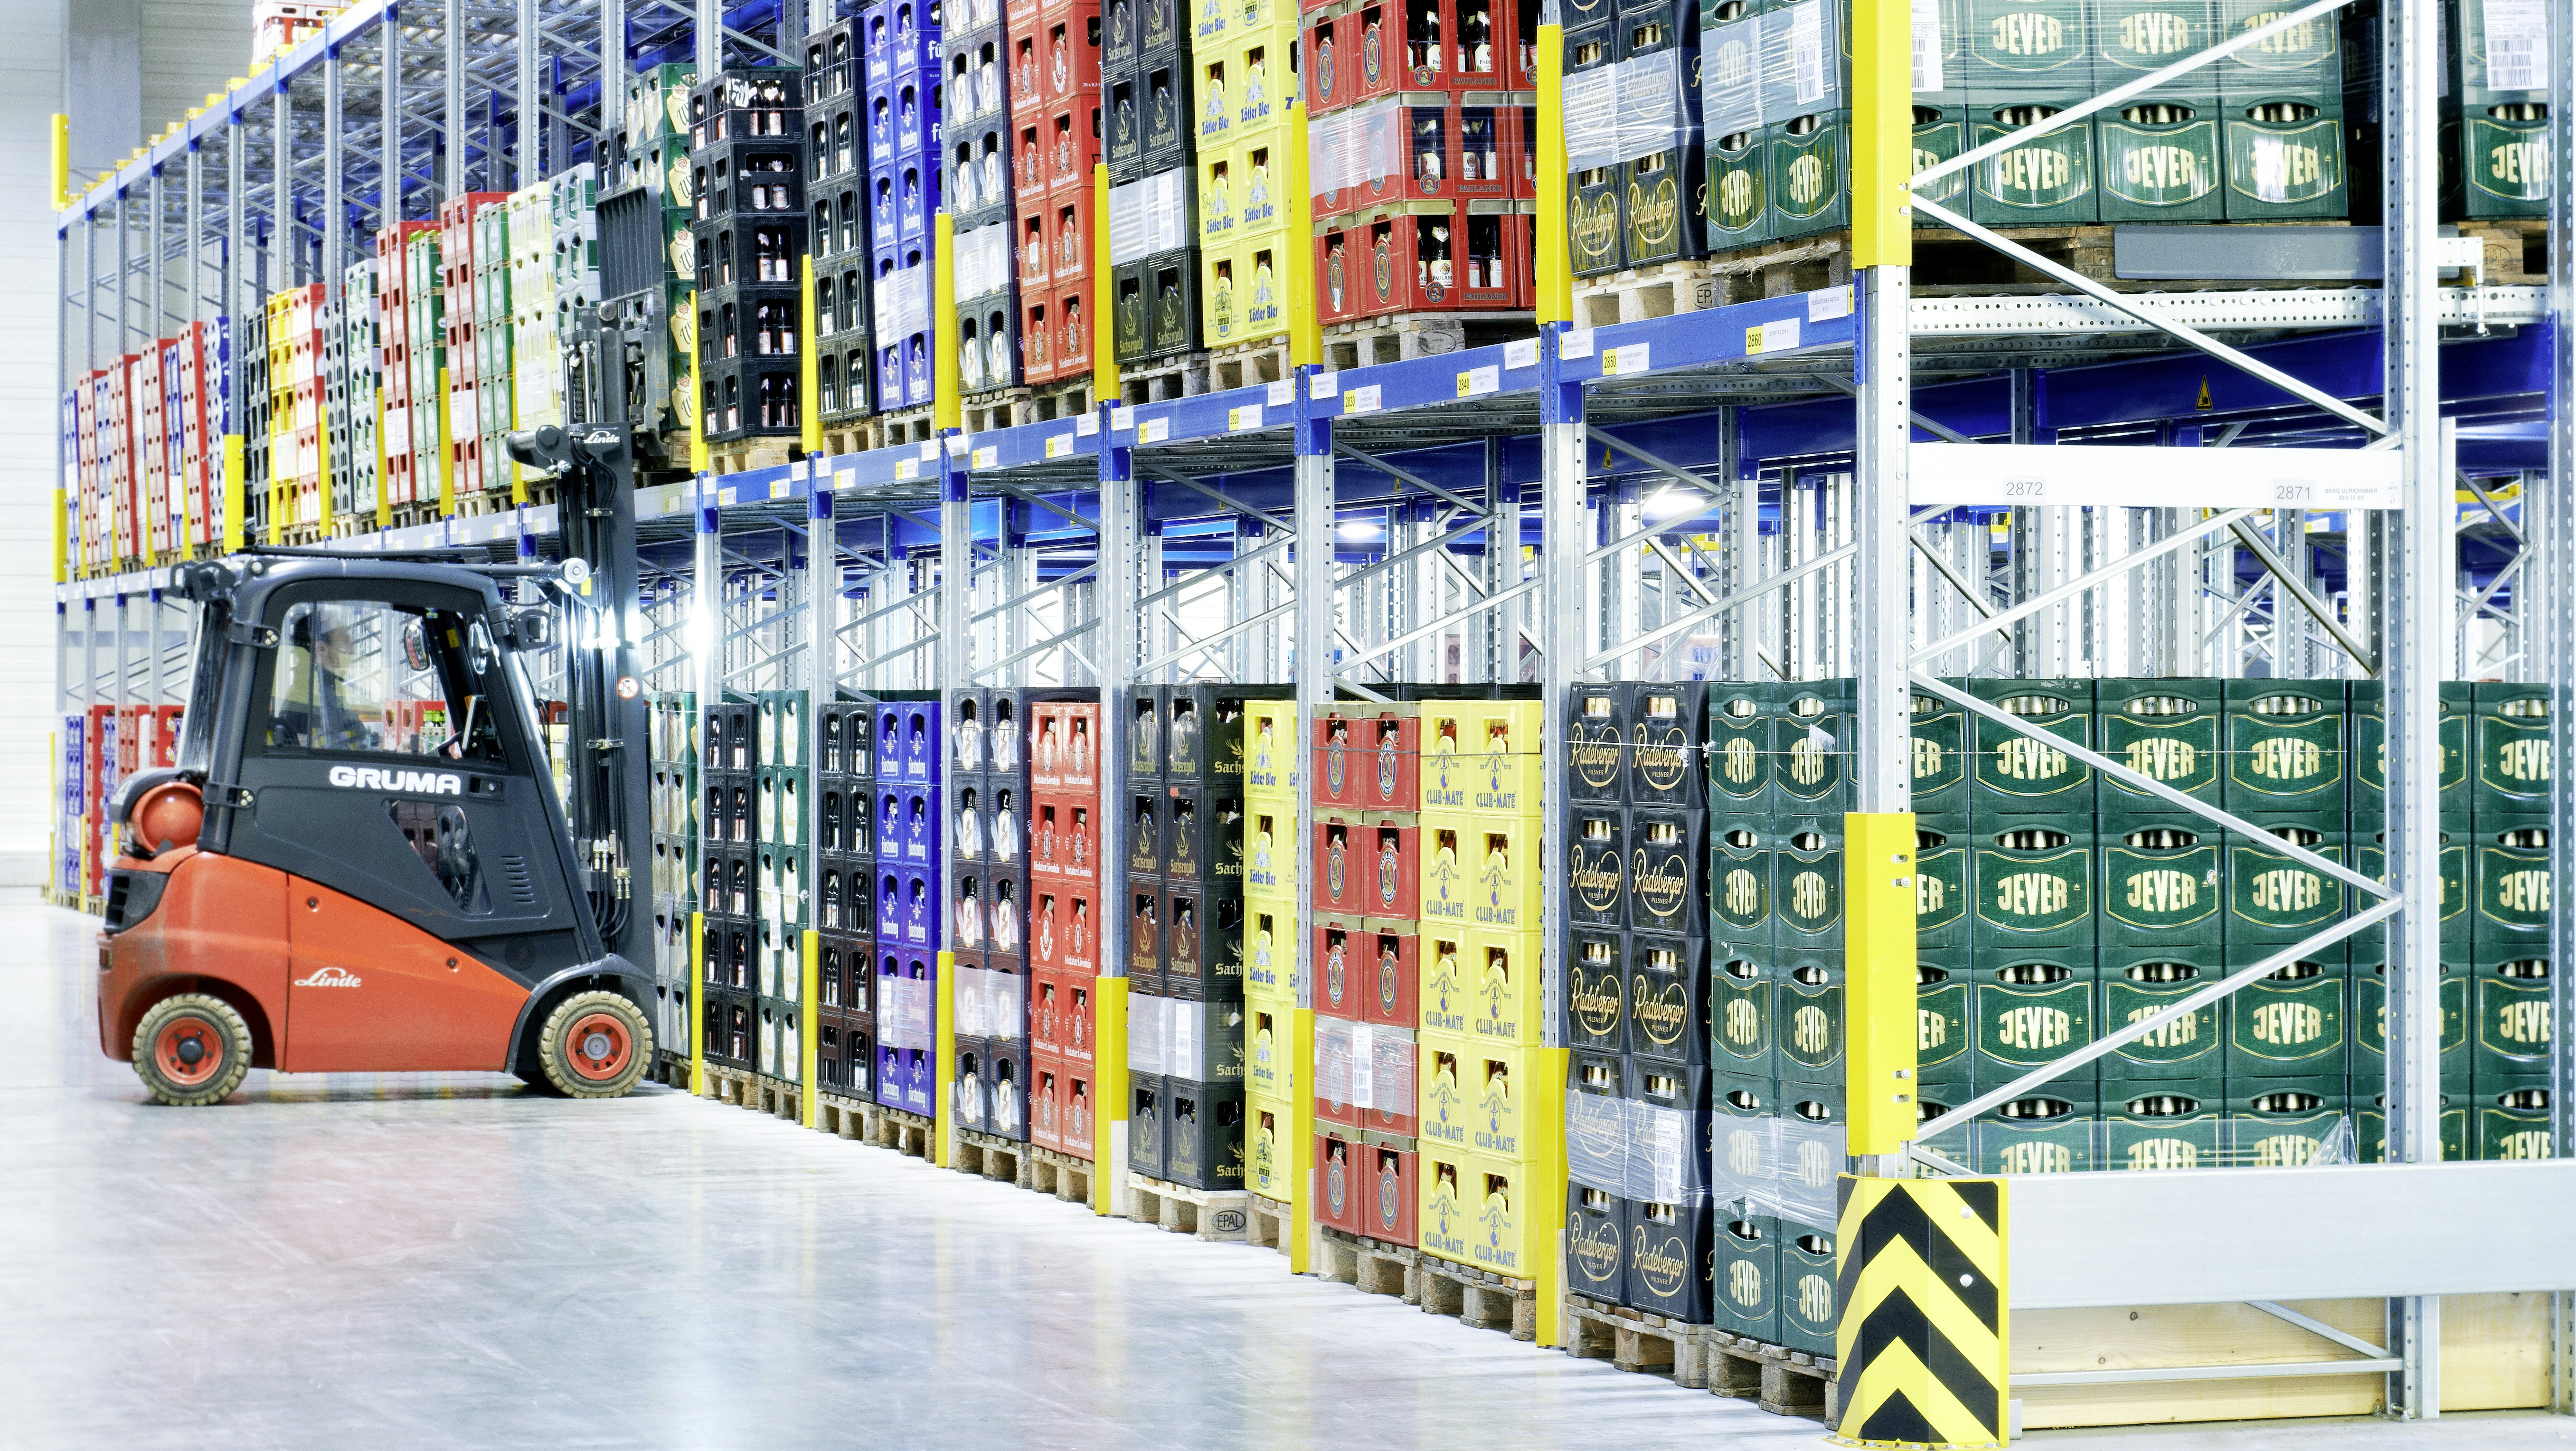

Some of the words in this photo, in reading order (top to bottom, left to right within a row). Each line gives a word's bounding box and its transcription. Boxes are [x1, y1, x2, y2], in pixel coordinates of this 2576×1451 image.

[1247, 12, 1256, 21] BIER
[1198, 20, 1213, 37] Zötler
[1215, 17, 1226, 31] Bier
[1992, 14, 2063, 55] JEVER
[2119, 13, 2188, 54] JEVER
[1145, 28, 1170, 48] Sachsengold
[1107, 41, 1132, 61] Sachsengold
[1453, 76, 1496, 85] PAULANER
[1241, 106, 1257, 123] Zötler
[1259, 103, 1270, 115] Bier
[1202, 119, 1217, 136] Zötler
[1219, 117, 1229, 130] Bier
[2001, 146, 2068, 190] JEVER
[2492, 142, 2547, 183] JEVE
[1458, 184, 1502, 193] PAULANER
[1722, 170, 1752, 217] JEVER
[1245, 206, 1261, 223] Zötler
[1263, 203, 1273, 217] Bier
[1628, 182, 1676, 230] Radeberger
[1464, 292, 1508, 301] PAULANER
[1249, 307, 1265, 323] Zötler
[1267, 304, 1278, 319] Bier
[1158, 327, 1184, 346] Sachsengold
[1220, 325, 1228, 333] BIER
[1119, 336, 1143, 354] Sachsengold
[1748, 333, 1762, 348] 2860
[1604, 355, 1616, 368] 2850
[1458, 378, 1469, 391] 2840
[1345, 396, 1355, 408] 2830
[1230, 414, 1239, 425] 2820
[583, 431, 620, 443] Linde
[1139, 428, 1148, 439] 2810
[2006, 482, 2043, 496] 2872
[2277, 486, 2311, 500] 2871
[1570, 722, 1618, 774] Radeberger
[1171, 760, 1195, 775] Sachsengold
[1725, 738, 1755, 784] JEVER
[1791, 738, 1823, 785] JEVER
[2126, 740, 2194, 780] JEVER
[2252, 739, 2319, 779] JEVER
[2500, 739, 2549, 781] JEVE
[330, 766, 461, 794] GRUMA
[1250, 770, 1265, 785] Zötler
[1266, 772, 1276, 786] Bier
[1427, 790, 1463, 805] CLUB-MATE
[1476, 793, 1515, 808] CLUB-MATE
[1133, 854, 1156, 869] Sachsengold
[1633, 849, 1684, 904] Radeberger
[1793, 872, 1826, 919] JEVER
[1998, 874, 2067, 915] JEVER
[2127, 871, 2195, 911] JEVER
[1476, 906, 1515, 925] CLUB-MATE
[1133, 954, 1156, 970] Sachsengold
[1171, 957, 1196, 976] Sachsengold
[295, 967, 361, 988] Linde
[1250, 967, 1264, 983] Zötler
[1266, 970, 1276, 985] Bier
[1569, 967, 1618, 1023] Radeberger
[1633, 975, 1684, 1031] Radeberger
[1426, 1011, 1463, 1031] CLUB-MATE
[1727, 999, 1757, 1045] JEVER
[1795, 1006, 1827, 1054] JEVER
[2000, 1007, 2069, 1049] JEVER
[2500, 1001, 2549, 1043] JEVE
[1254, 1065, 1266, 1079] Zötler
[1425, 1121, 1463, 1142] CLUB-MATE
[1475, 1132, 1515, 1153] CLUB-MATE
[1728, 1129, 1759, 1176] JEVER
[1797, 1141, 1830, 1187] JEVER
[1260, 1176, 1268, 1184] BIER
[1218, 1213, 1239, 1228] EPAL
[1569, 1212, 1617, 1268] Radeberger
[1474, 1244, 1515, 1267] CLUB-MATE
[1633, 1225, 1683, 1282] Radeberger
[1651, 1277, 1668, 1285] PILSNER
[1730, 1261, 1760, 1307] JEVER
[1799, 1276, 1831, 1323] JEVER
